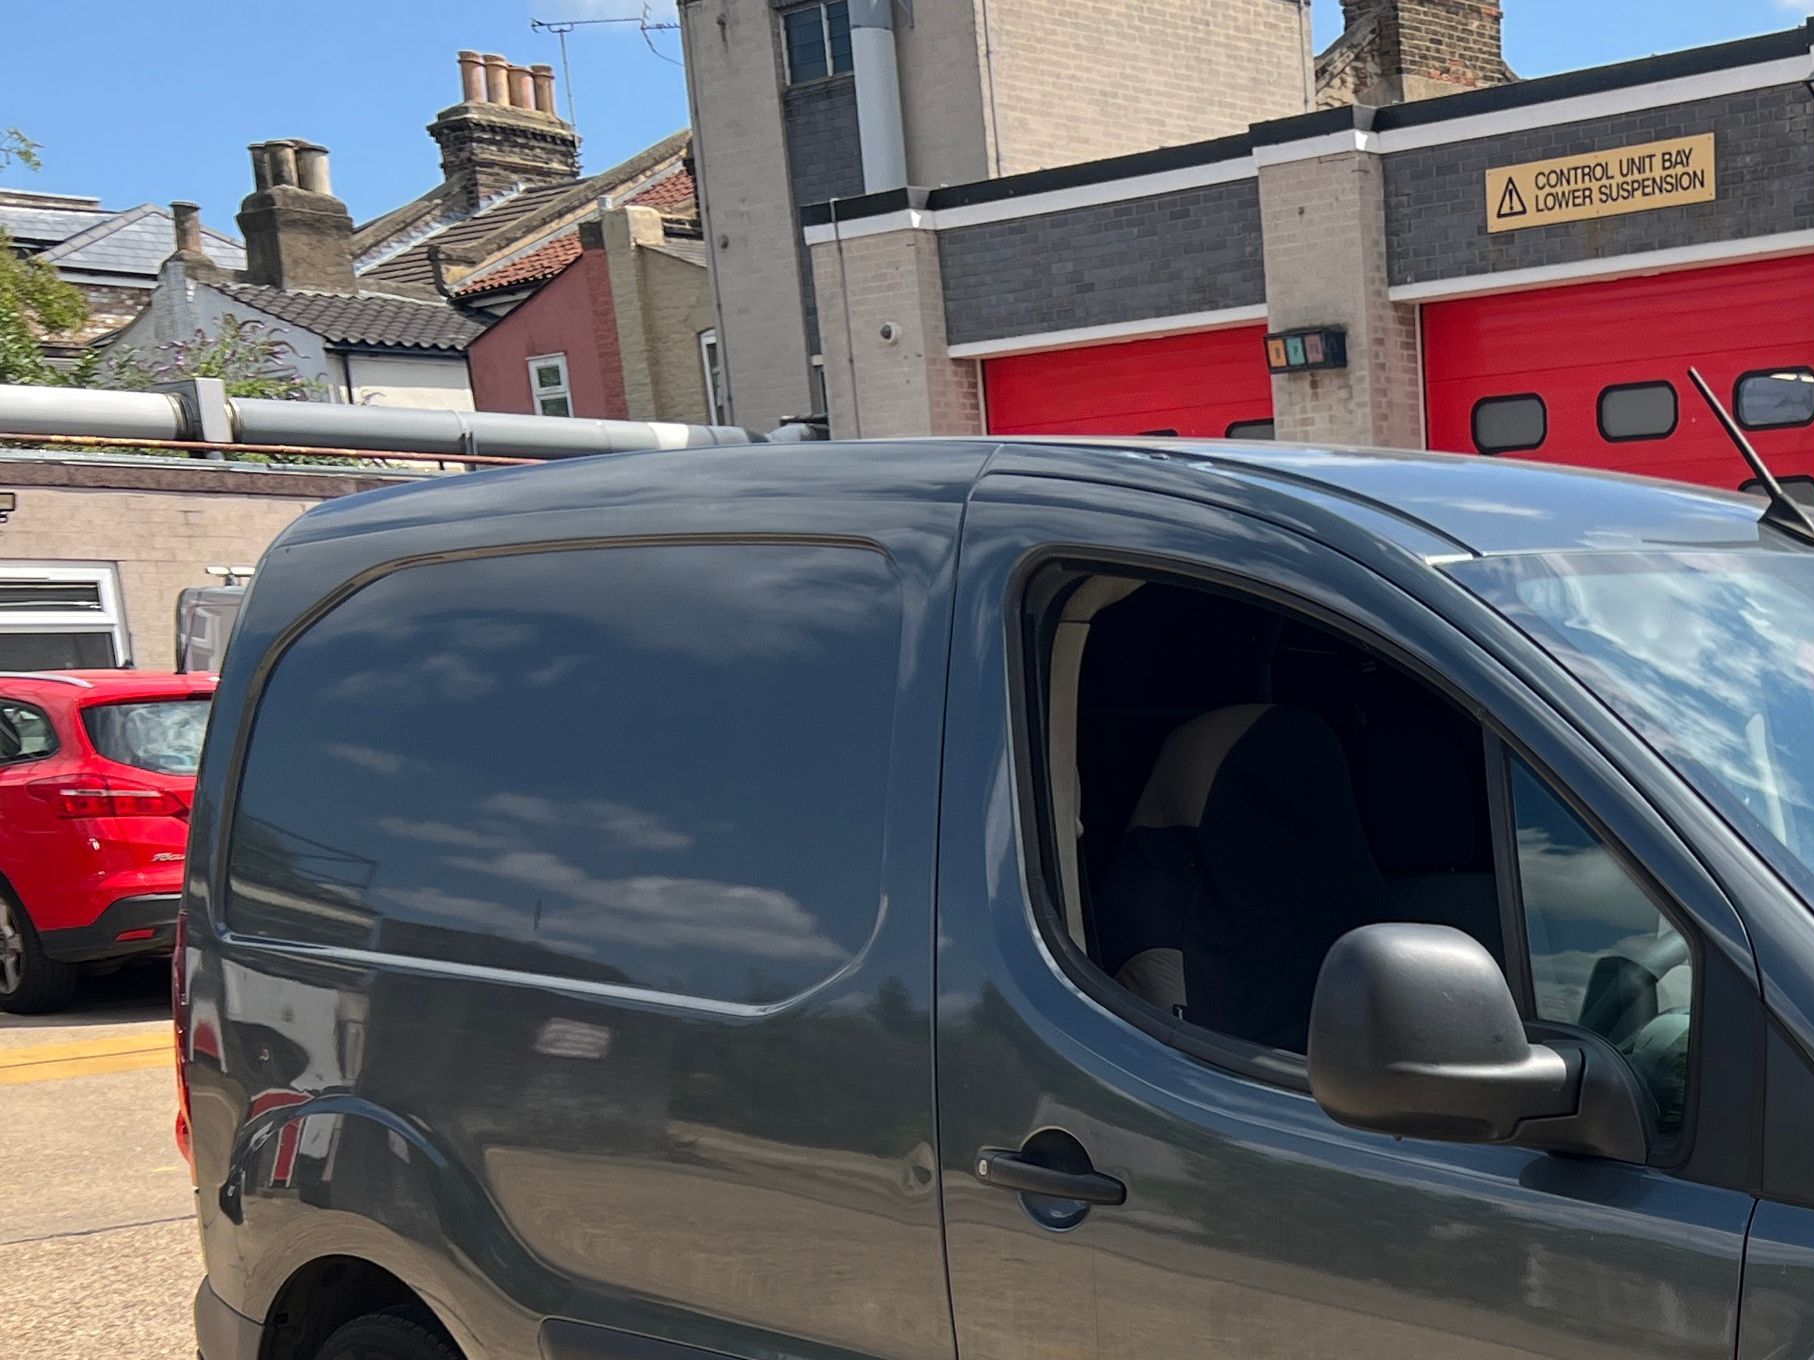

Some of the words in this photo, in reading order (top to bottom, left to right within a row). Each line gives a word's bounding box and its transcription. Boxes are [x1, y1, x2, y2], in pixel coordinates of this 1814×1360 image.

[1535, 162, 1614, 190] CONTROL
[1619, 154, 1656, 177] UNIT
[1661, 148, 1693, 170] BAY
[1535, 187, 1593, 212] LOWER
[1599, 168, 1704, 203] SUSPENSION
